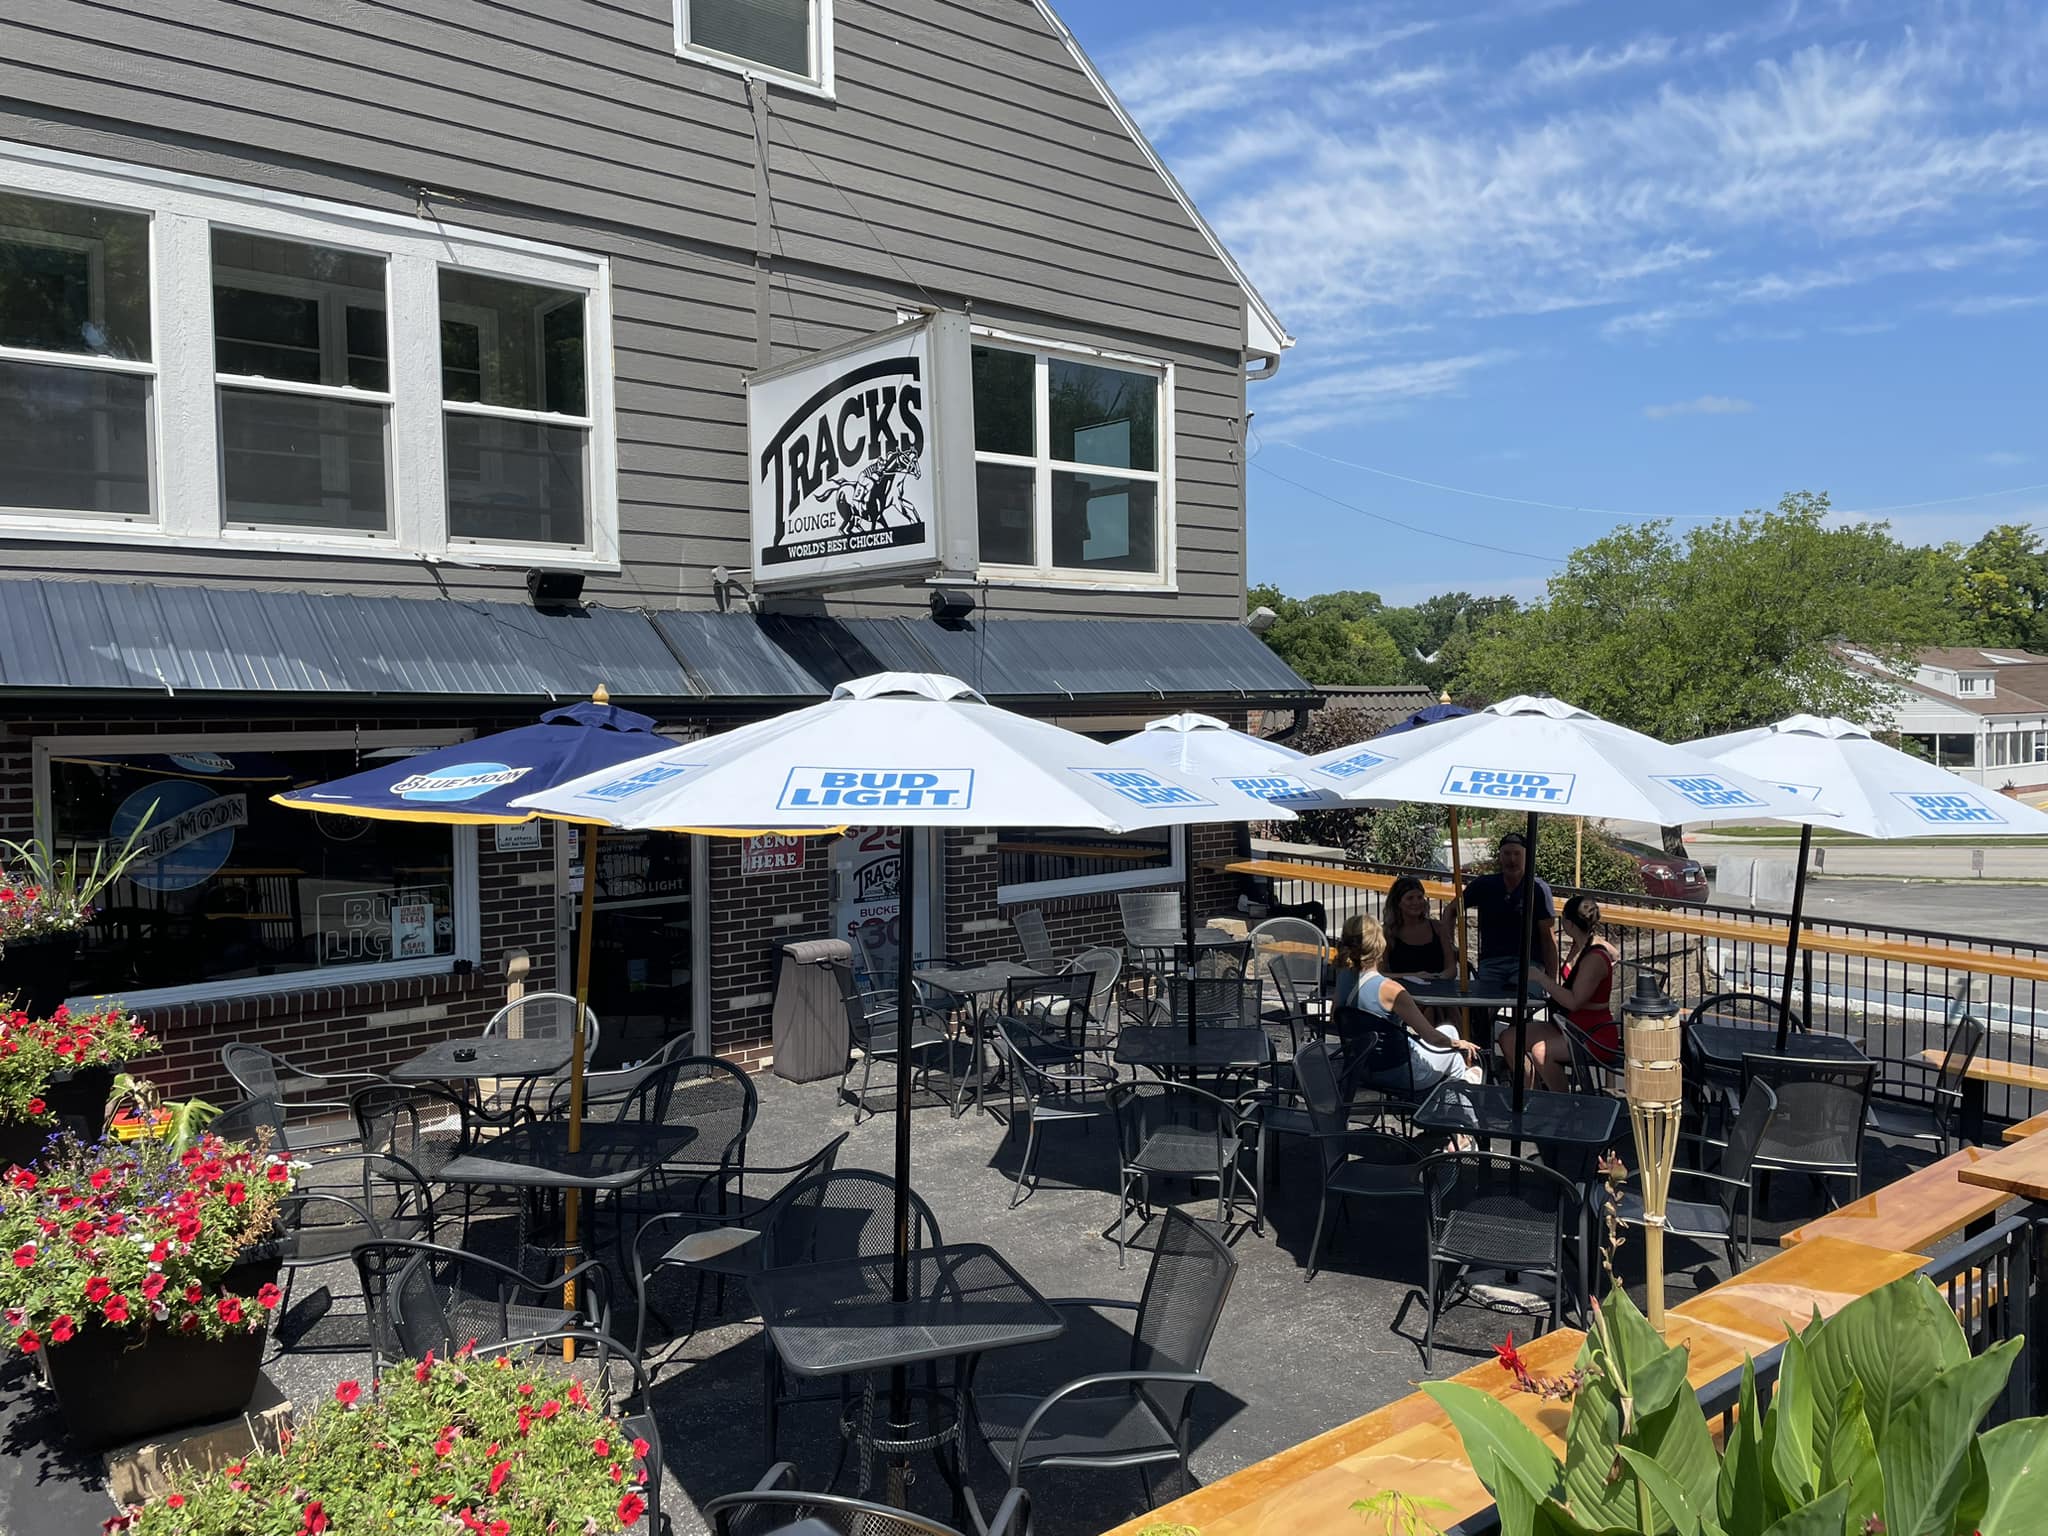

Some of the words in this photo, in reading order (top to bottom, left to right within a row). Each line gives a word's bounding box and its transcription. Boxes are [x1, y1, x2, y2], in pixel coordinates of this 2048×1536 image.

[761, 357, 924, 546] TRACKS
[788, 512, 836, 534] LOUNGE
[788, 541, 825, 558] WORLD'S
[827, 538, 848, 553] BEST
[849, 531, 893, 549] CHICKEN
[394, 777, 461, 791] BLUE
[461, 770, 523, 785] MOON
[821, 772, 939, 788] BUD
[1091, 772, 1161, 787] BUD
[1231, 778, 1289, 790] BUD
[1470, 771, 1549, 786] BUD
[1667, 778, 1724, 792] BUD
[791, 788, 960, 806] LIGHT
[1115, 787, 1200, 803] LIGHT
[1244, 787, 1310, 800] IGHT
[1450, 781, 1563, 800] LIGHT
[1682, 790, 1757, 805] LIGHT
[1909, 796, 1968, 808] BUD
[1916, 808, 1995, 820] LIGHT
[751, 835, 798, 849] KENO
[752, 852, 797, 869] HERE
[853, 854, 900, 899] TRACK
[648, 879, 683, 892] LIGHT
[860, 905, 899, 917] BUCKE
[325, 927, 392, 960] LIG
